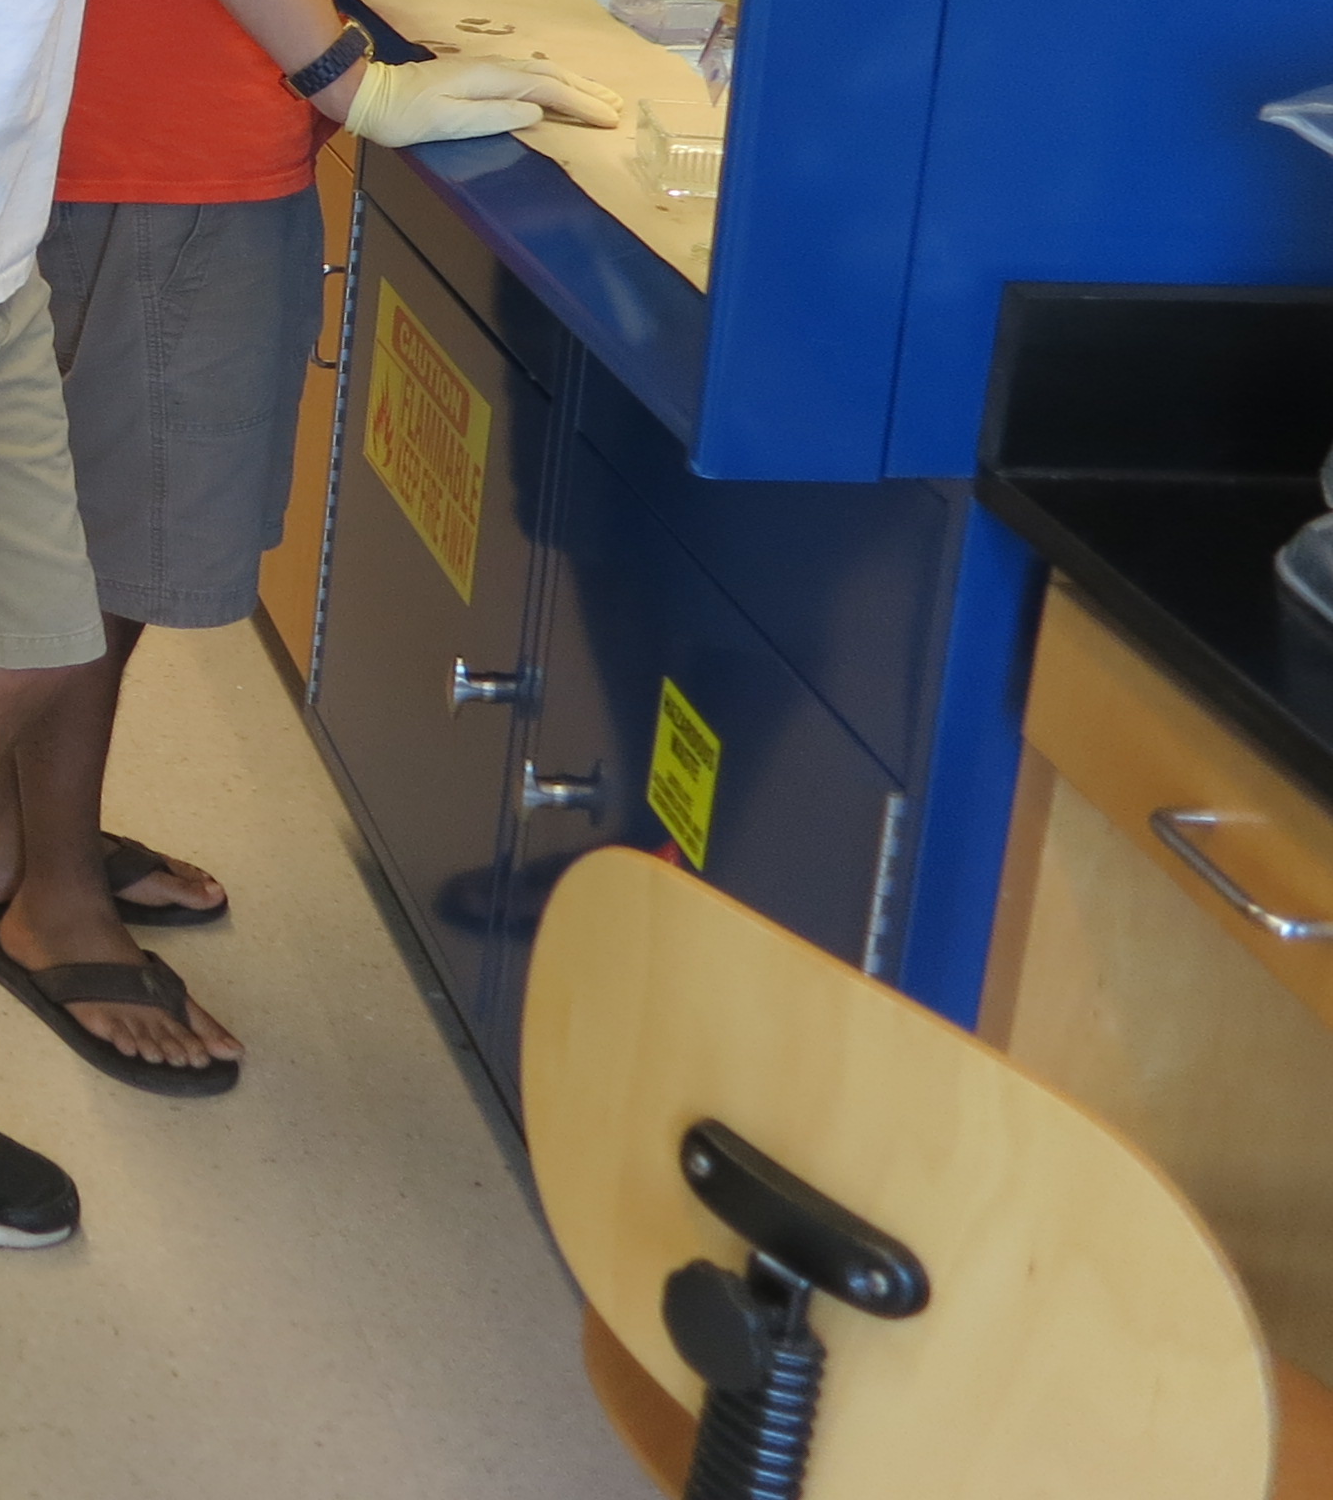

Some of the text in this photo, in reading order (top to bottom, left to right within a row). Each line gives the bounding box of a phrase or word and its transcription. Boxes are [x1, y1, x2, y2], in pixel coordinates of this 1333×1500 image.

[398, 318, 462, 424] CAUTION
[394, 433, 473, 590] KEEP FIRE AWAY
[400, 373, 481, 526] FLAMMABLE
